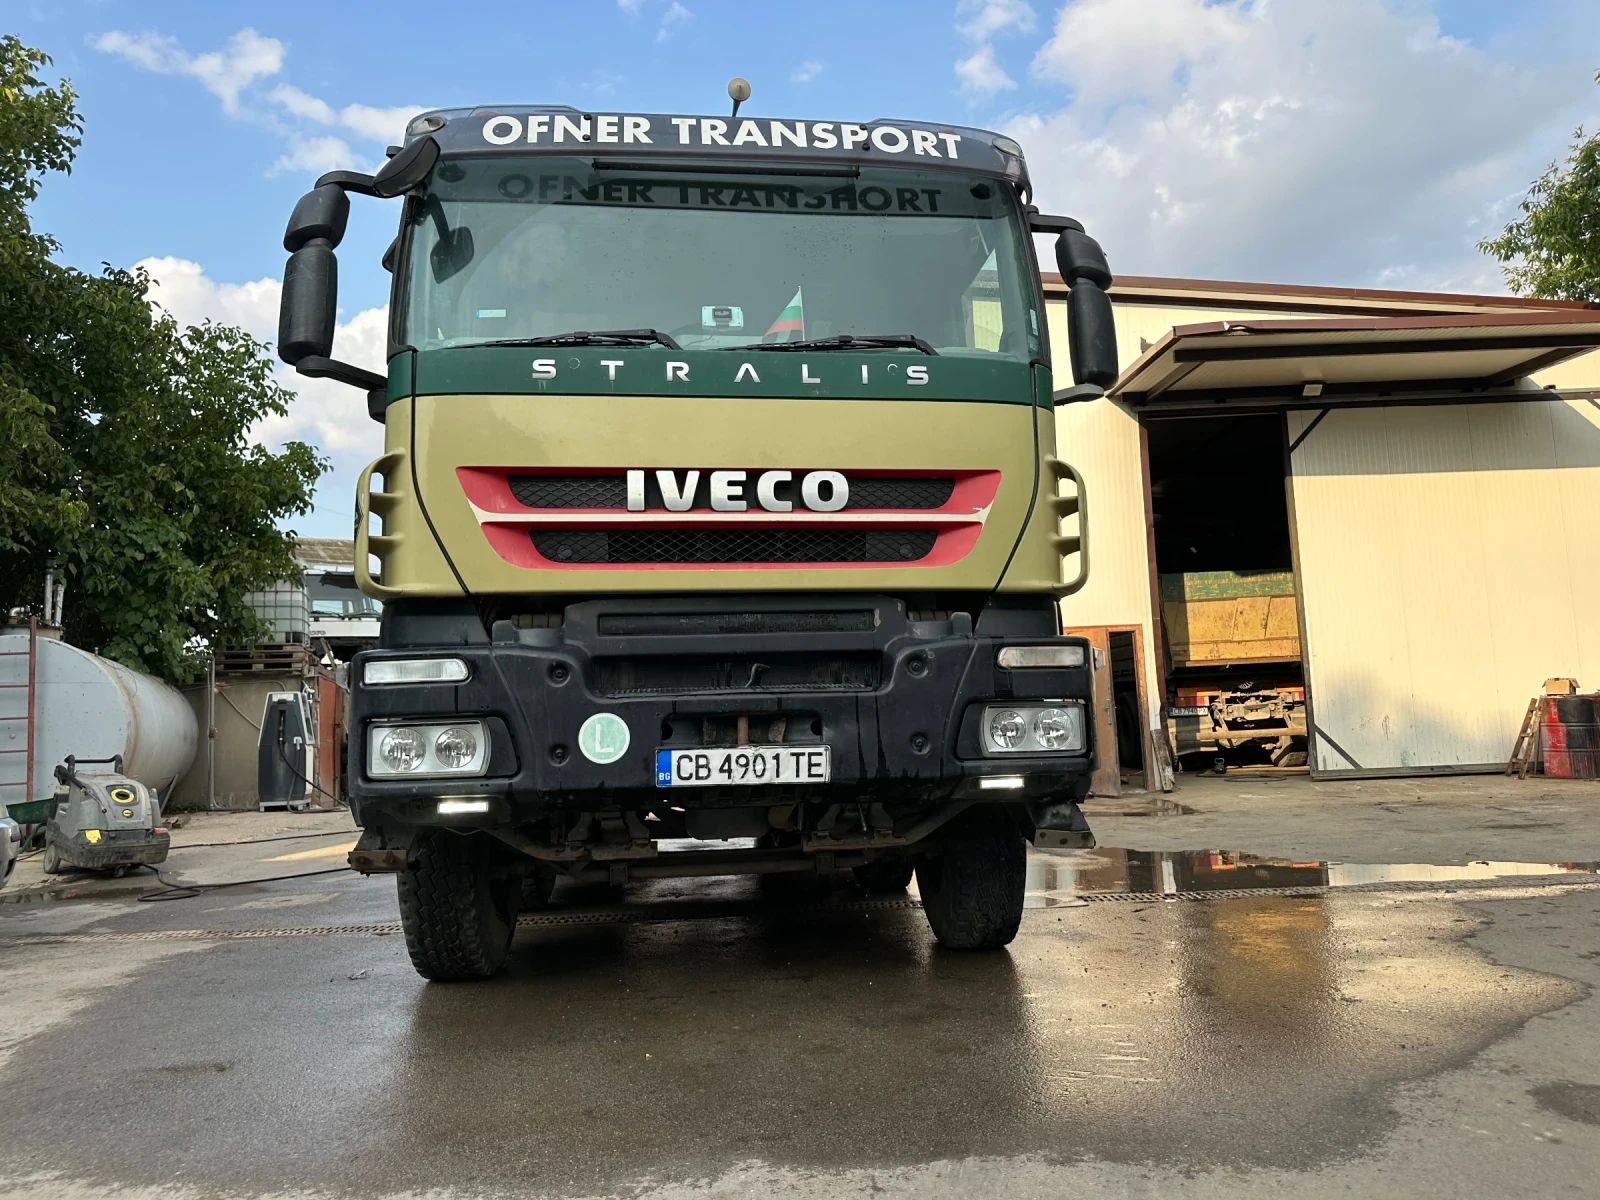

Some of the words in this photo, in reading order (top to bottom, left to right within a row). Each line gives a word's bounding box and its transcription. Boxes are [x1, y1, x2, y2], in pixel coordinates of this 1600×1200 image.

[482, 114, 653, 146] OFNER
[671, 117, 961, 160] TRANSPORT
[498, 173, 654, 203] OFNER
[532, 358, 929, 386] STRALIS
[626, 470, 849, 512] IVECO
[595, 723, 615, 753] L
[658, 772, 671, 781] BG
[676, 754, 712, 781] CB
[718, 752, 781, 780] 4901
[790, 751, 824, 778] TE
